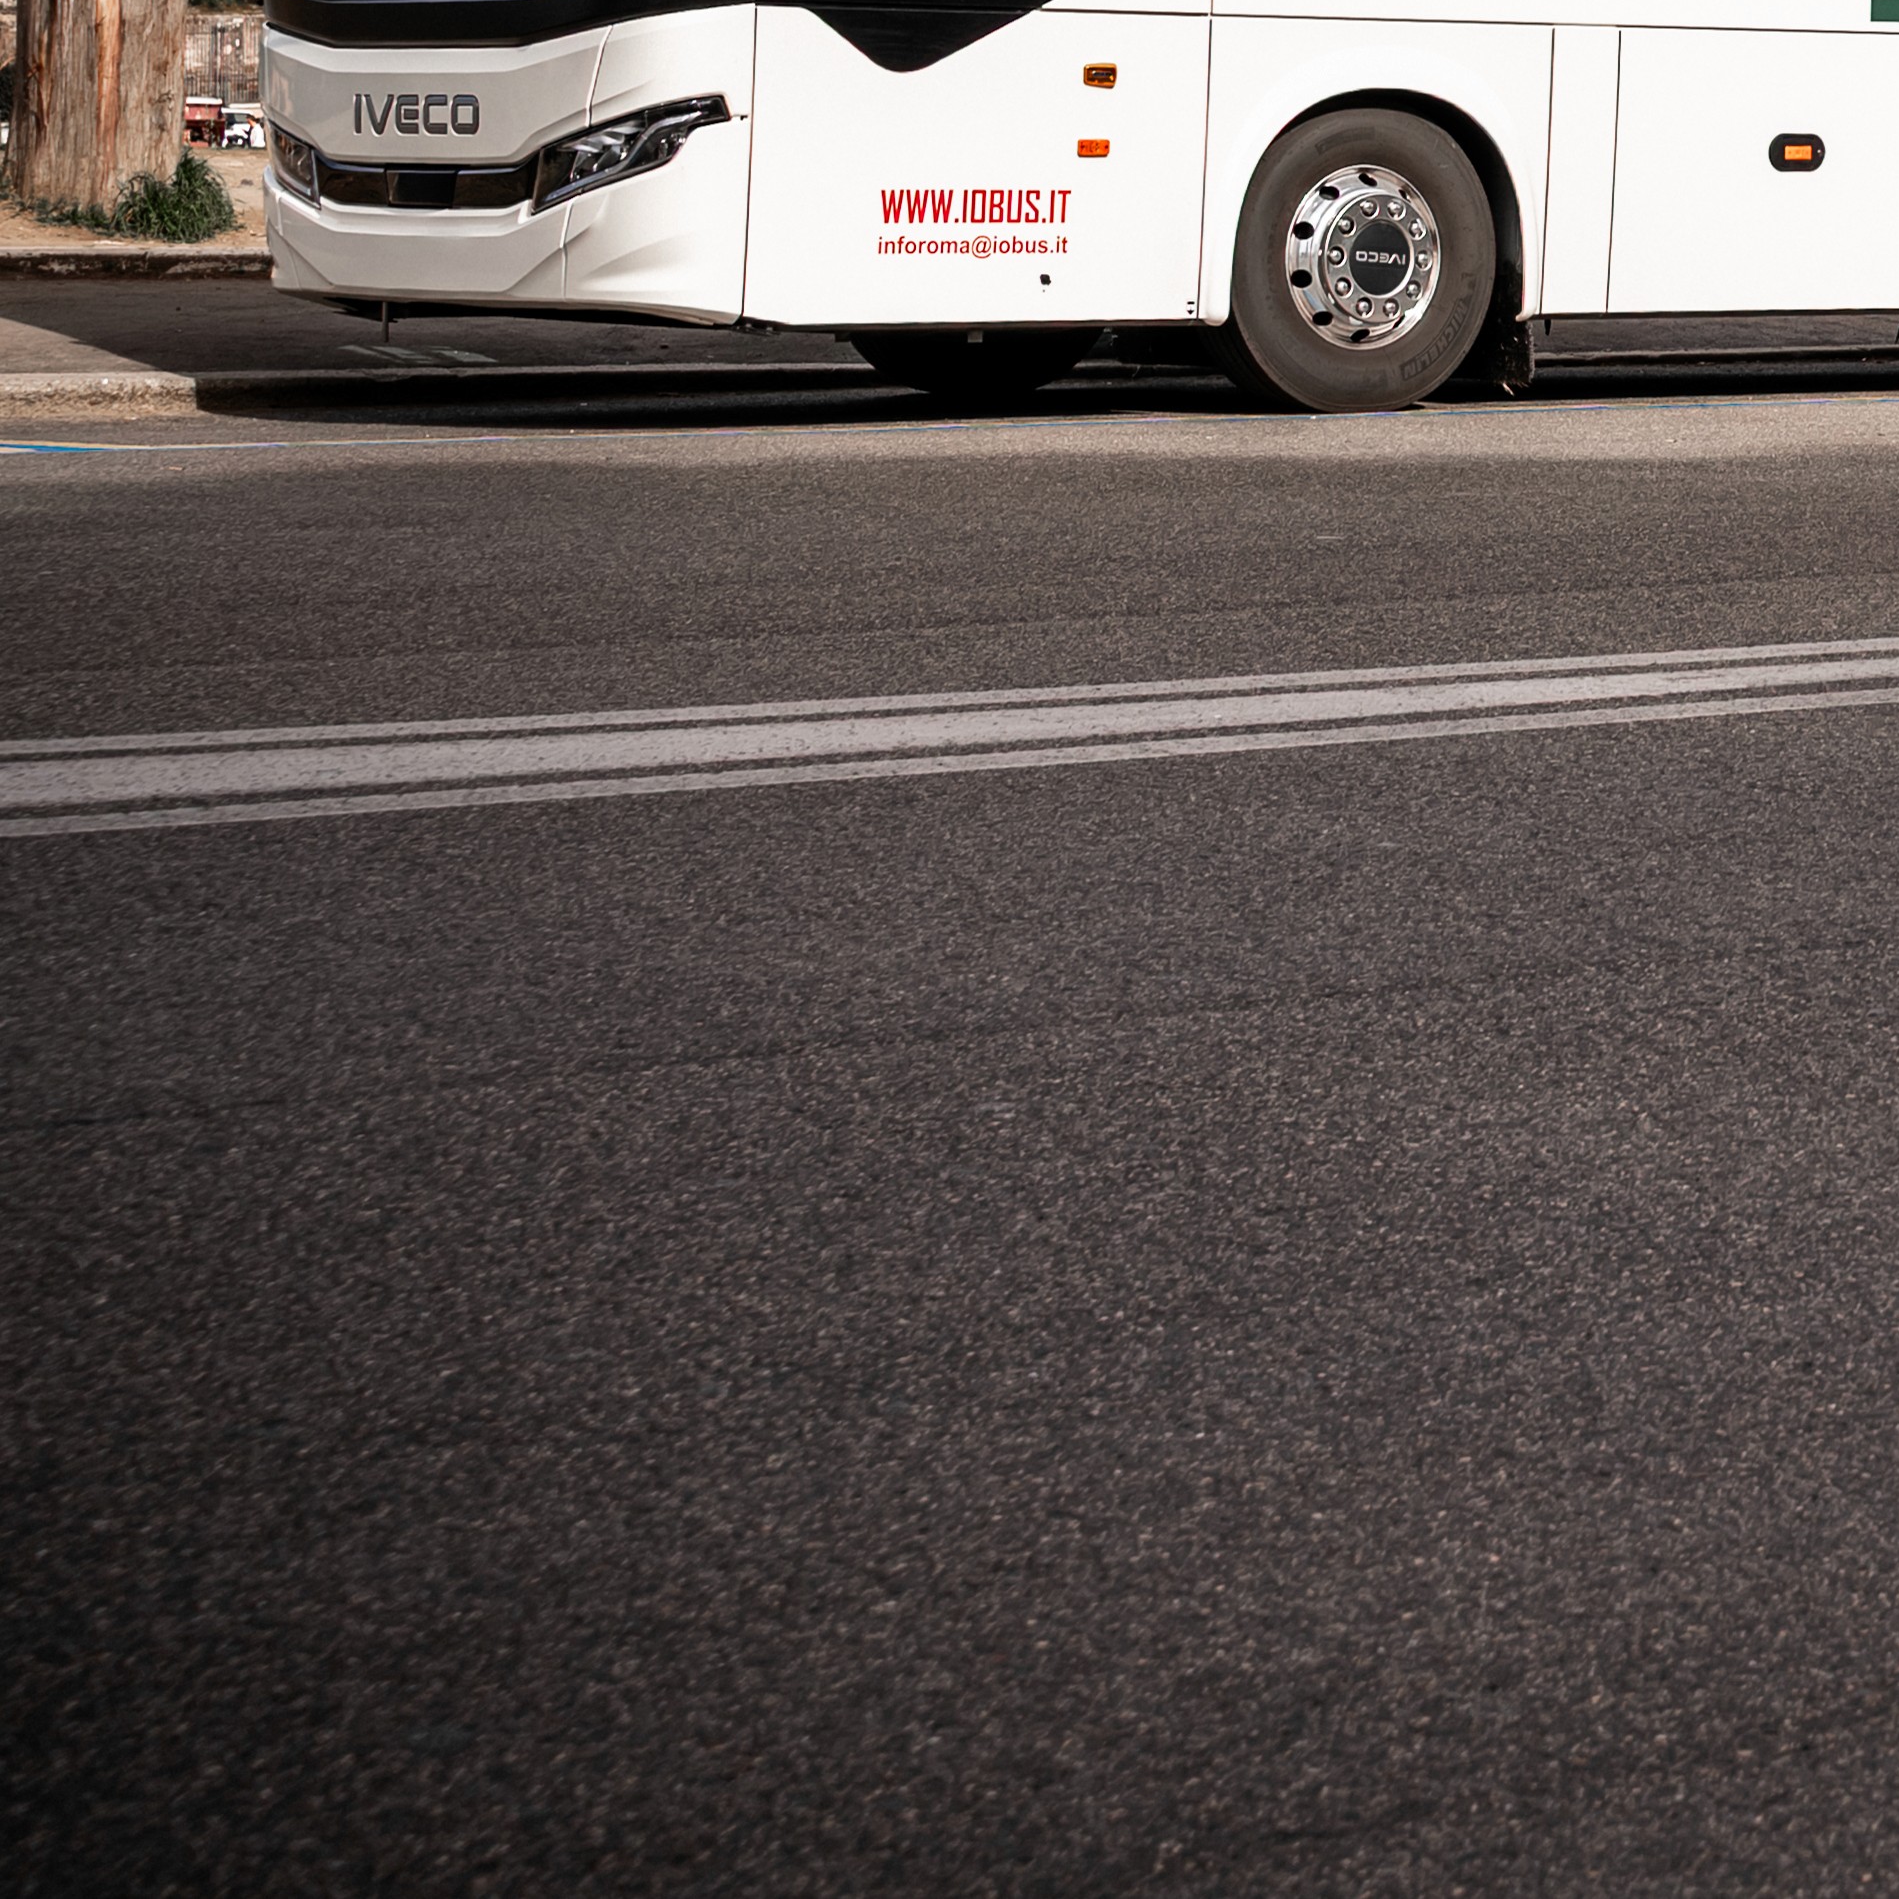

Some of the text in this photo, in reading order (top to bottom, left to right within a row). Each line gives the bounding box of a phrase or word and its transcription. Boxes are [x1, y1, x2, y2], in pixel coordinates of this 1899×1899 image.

[353, 94, 480, 136] IVECO
[881, 189, 1071, 223] WWW.IOBUS.IT
[878, 235, 1068, 259] inforoma@iobus.it
[1355, 250, 1406, 265] IVECO
[1403, 301, 1467, 378] MICHELIN
